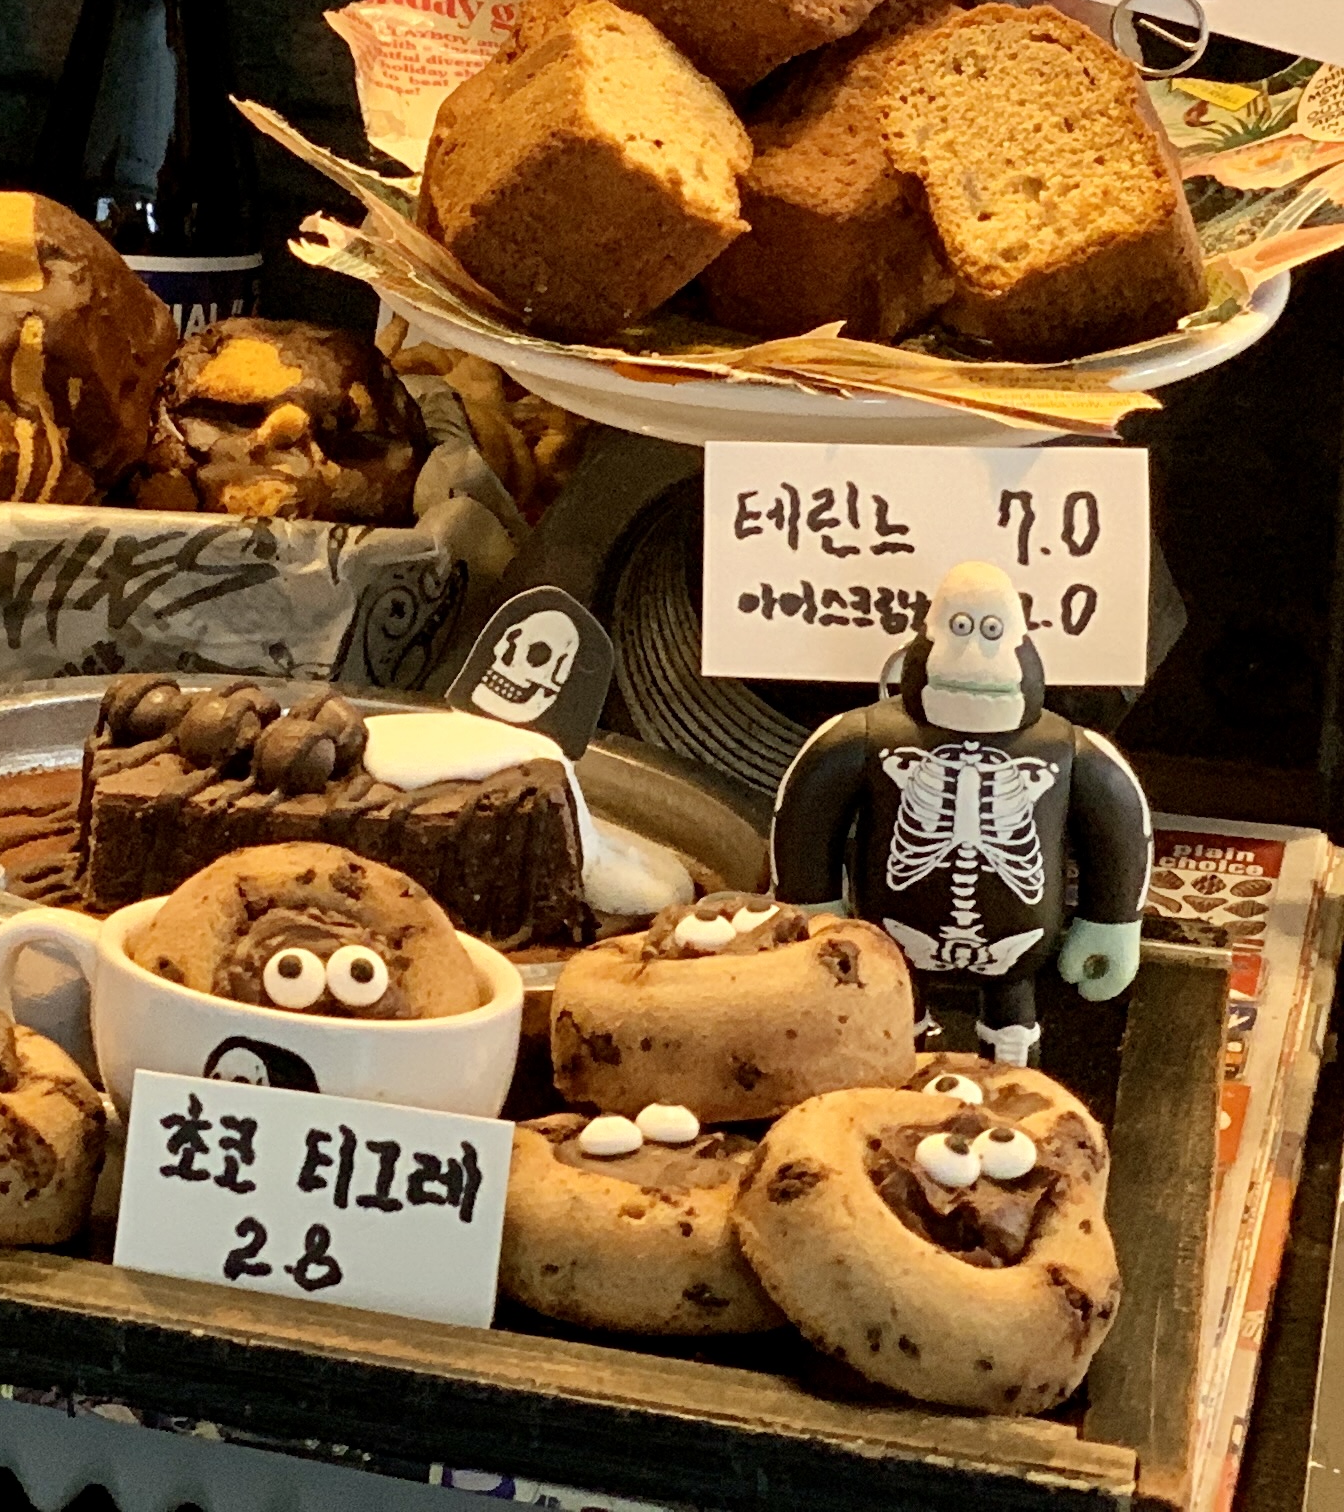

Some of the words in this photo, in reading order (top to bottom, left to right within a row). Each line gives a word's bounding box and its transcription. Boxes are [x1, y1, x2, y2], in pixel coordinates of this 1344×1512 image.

[998, 489, 1100, 565] 7.0
[1158, 855, 1264, 876] choice
[1172, 844, 1255, 863] plain
[158, 1092, 259, 1195] 초코
[299, 1124, 482, 1223] 티그레
